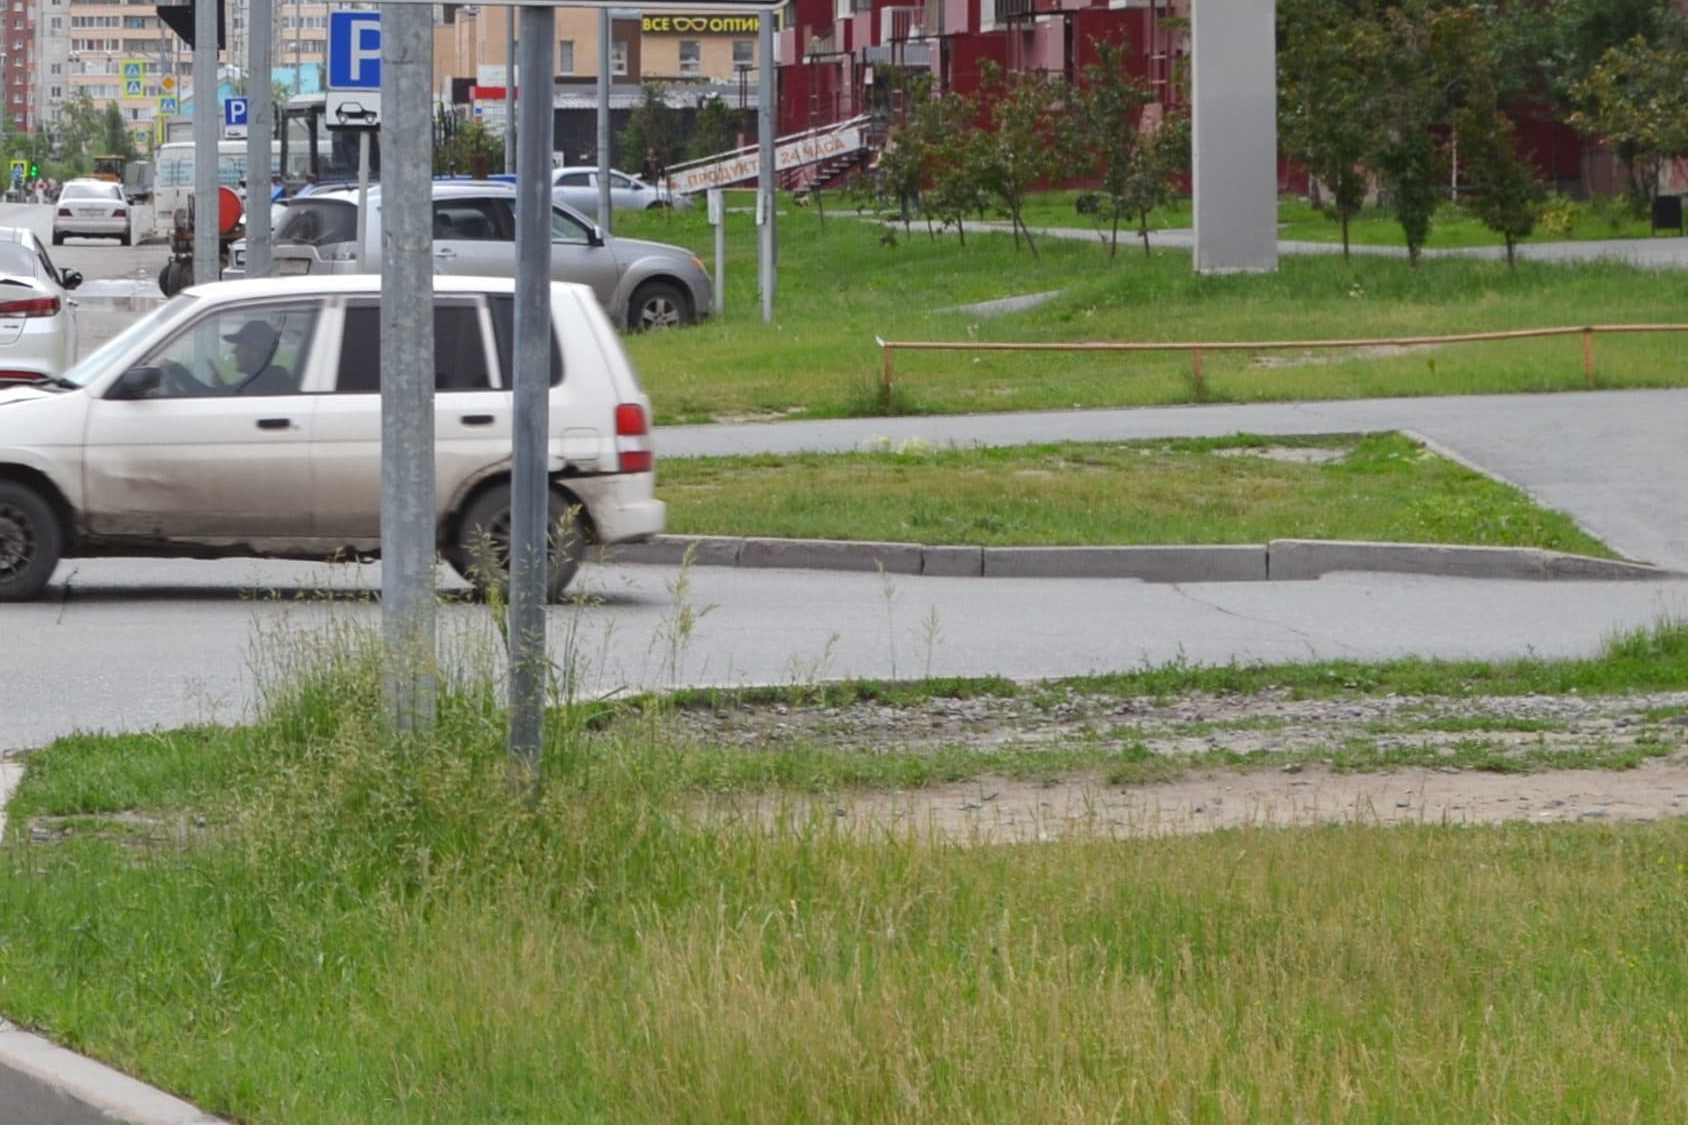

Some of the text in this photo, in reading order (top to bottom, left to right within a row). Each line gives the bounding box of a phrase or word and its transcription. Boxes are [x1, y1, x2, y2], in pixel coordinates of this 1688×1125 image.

[642, 17, 670, 31] ВСЕ
[230, 100, 246, 123] P
[688, 136, 846, 188] ПРОДУКТ 24 ЧАСА
